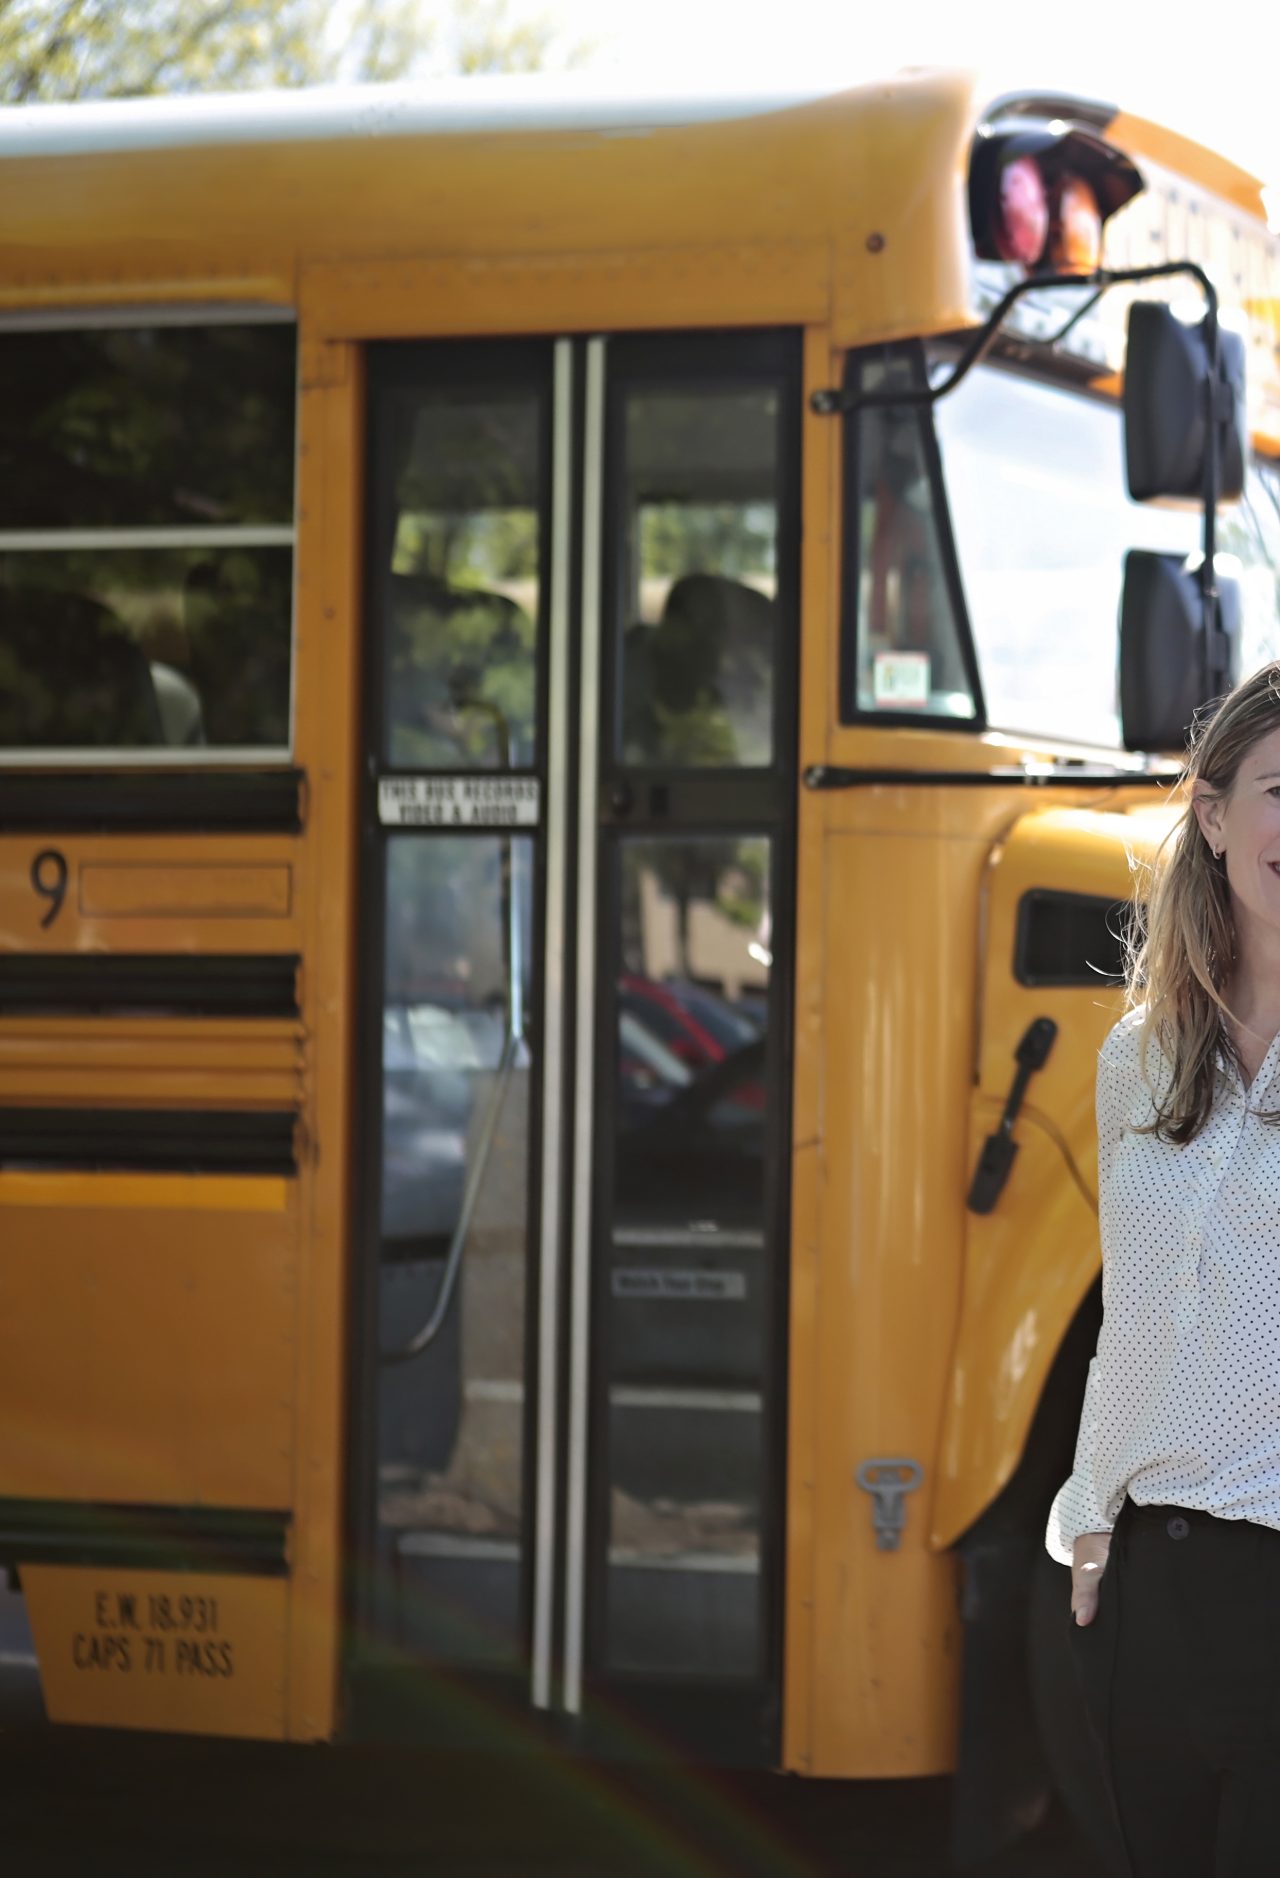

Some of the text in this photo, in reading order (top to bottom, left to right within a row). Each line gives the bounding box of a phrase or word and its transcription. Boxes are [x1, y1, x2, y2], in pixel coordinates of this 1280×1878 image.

[31, 846, 68, 931] 9
[72, 1632, 233, 1679] CAPS 71 PASS
